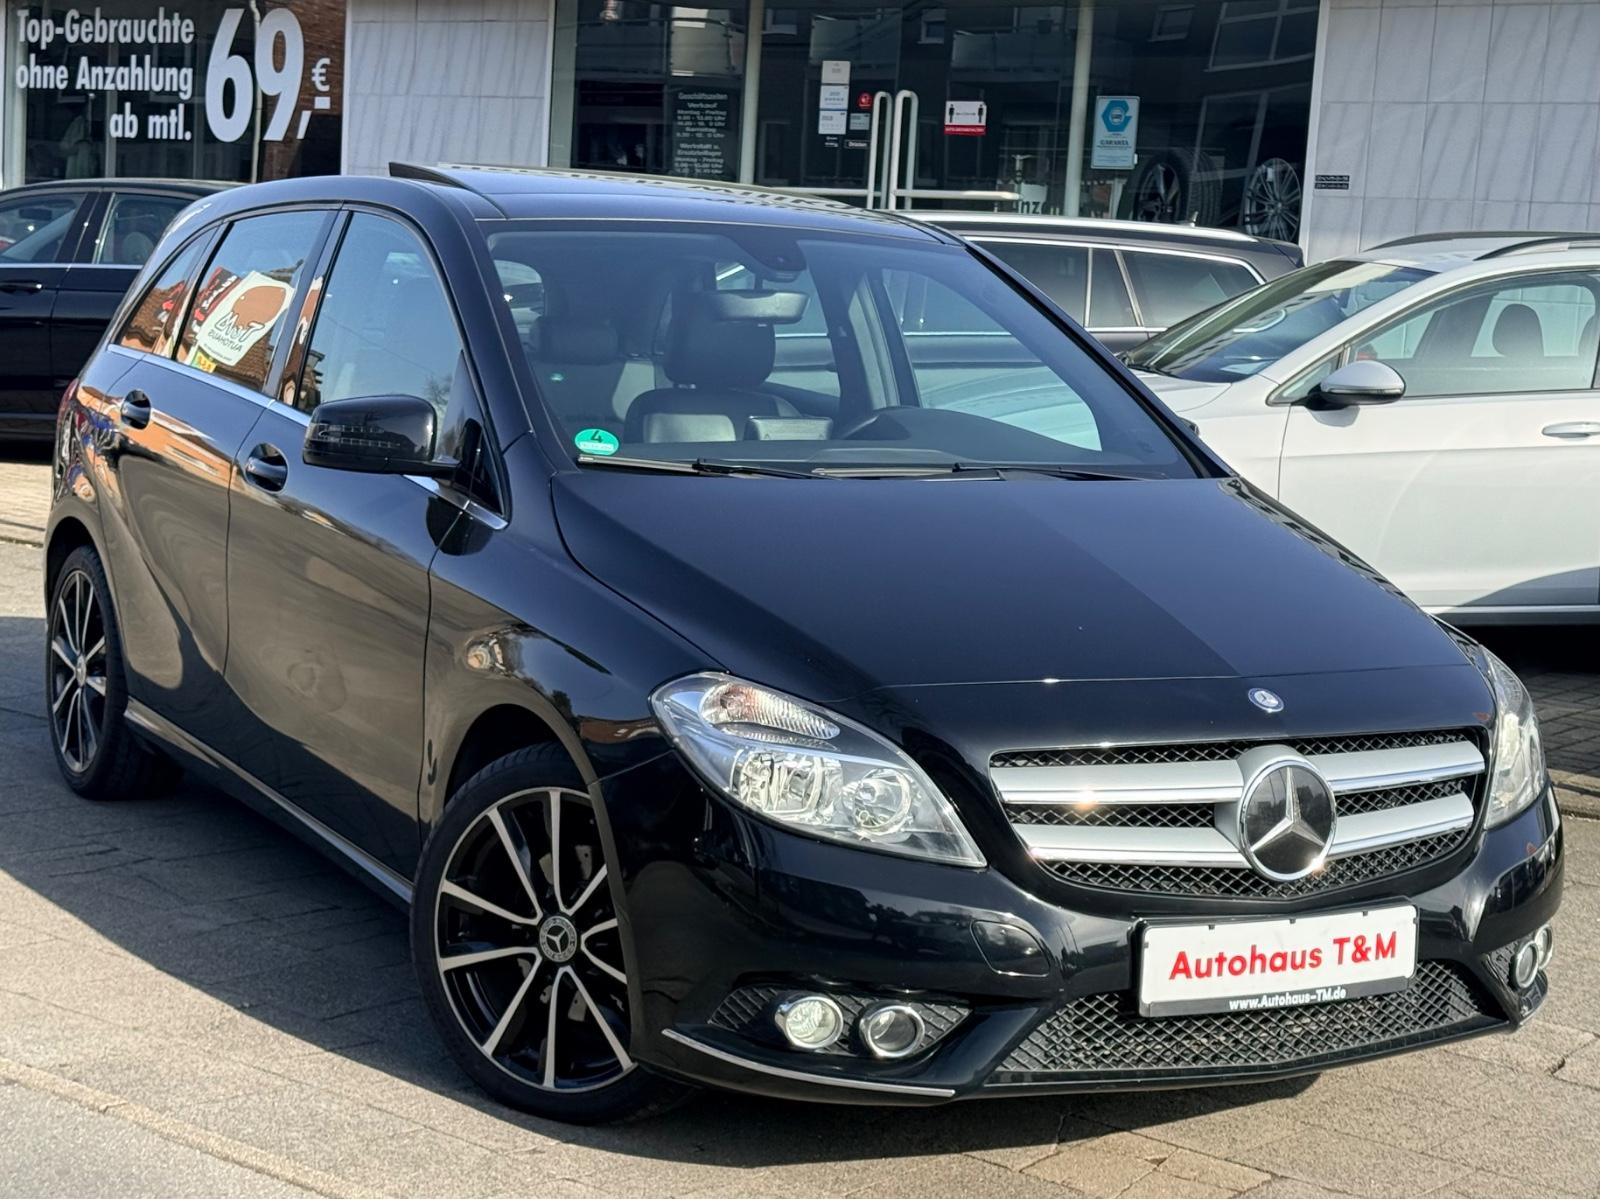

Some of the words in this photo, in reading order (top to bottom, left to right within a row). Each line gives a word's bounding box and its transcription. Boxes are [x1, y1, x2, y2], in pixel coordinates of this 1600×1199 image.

[16, 7, 194, 50] Top-Gebrauchte
[15, 54, 68, 89] ohne
[76, 55, 193, 100] Anzahlung
[311, 58, 331, 92] €
[110, 102, 138, 138] ab
[147, 103, 192, 141] mtl.
[591, 430, 603, 443] 4
[1168, 944, 1323, 980] Autohaus
[1333, 931, 1397, 965] T&M
[1229, 986, 1346, 1010] www.Autohaus-TM.de
